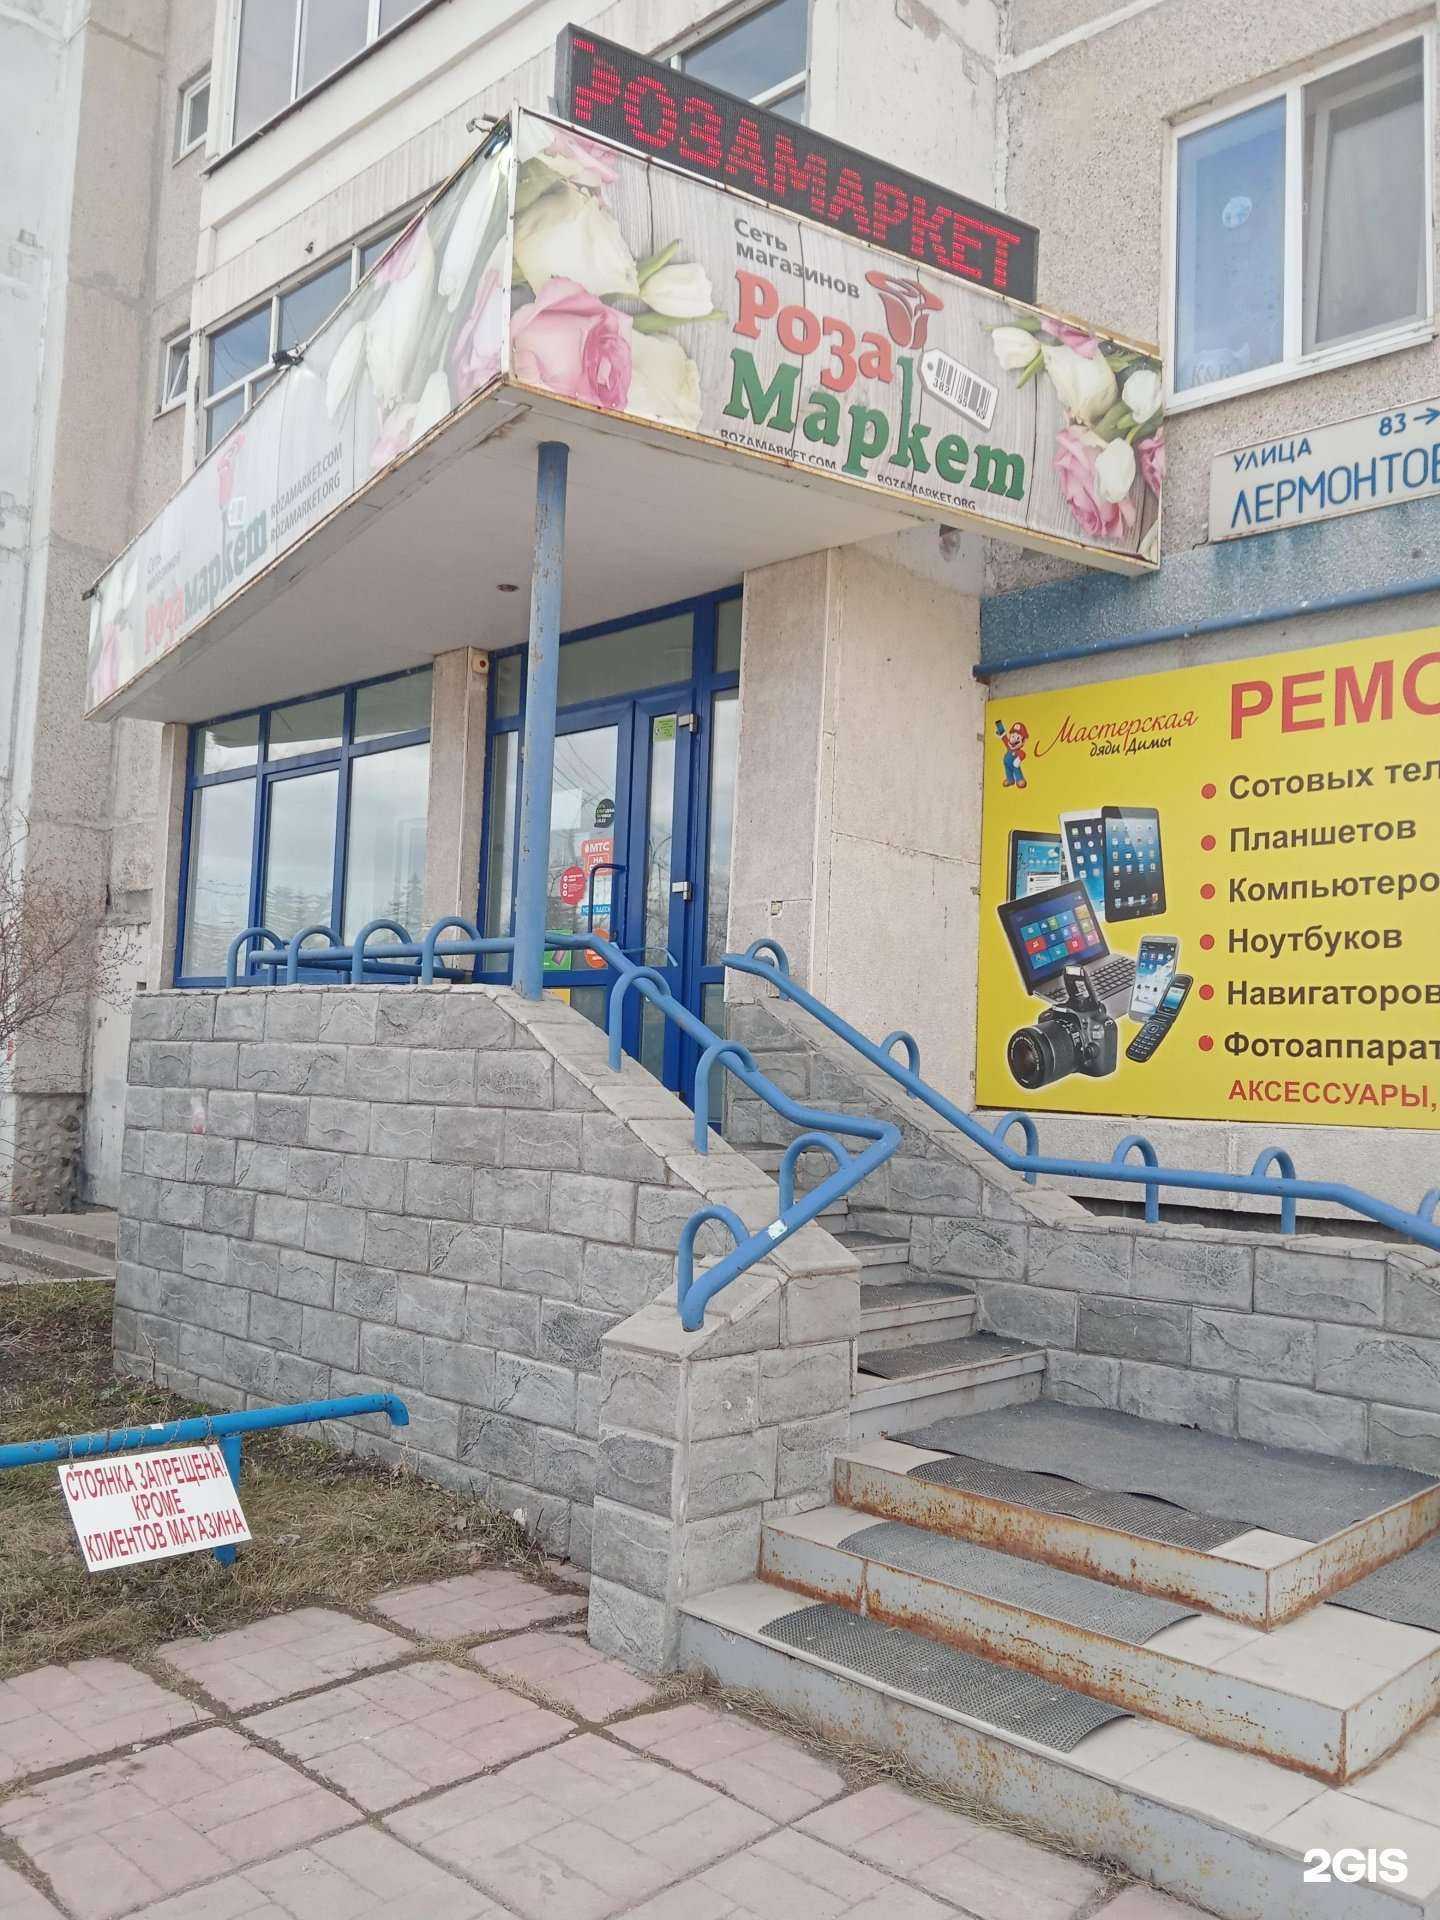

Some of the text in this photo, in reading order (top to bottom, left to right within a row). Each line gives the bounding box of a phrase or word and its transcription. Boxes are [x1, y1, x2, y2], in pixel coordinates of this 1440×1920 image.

[572, 38, 1020, 288] РОЗАМАРКЕТ
[734, 218, 788, 252] Сеть
[735, 242, 860, 299] магазинов
[733, 268, 895, 393] Роза
[1378, 412, 1406, 436] 83
[720, 428, 837, 470] ROZAMARKET.COM
[1233, 437, 1312, 472] УЛИЦА
[270, 441, 343, 520] ROZAMARKET.COM
[876, 473, 976, 511] ROZAMARKET.ORG
[270, 471, 341, 546] ROZAMARKET.ORG
[1034, 710, 1200, 758] Мастерская
[1089, 736, 1173, 758] дяди Димы
[1229, 766, 1375, 800] Сотовых
[1230, 819, 1417, 853] Планшетов
[1228, 871, 1440, 903] Компьютеро
[1227, 924, 1402, 959] Ноутбуков
[1227, 980, 1440, 1012] Навигаторов
[1228, 1079, 1438, 1113] АКСЕССУАРЫ,
[65, 1451, 228, 1501] СТОЯНКА ЗАПРЕЩЕНА!
[131, 1488, 185, 1521] КРОМЕ
[83, 1508, 246, 1562] КЛИЕНТОВ МАГАЗИНА
